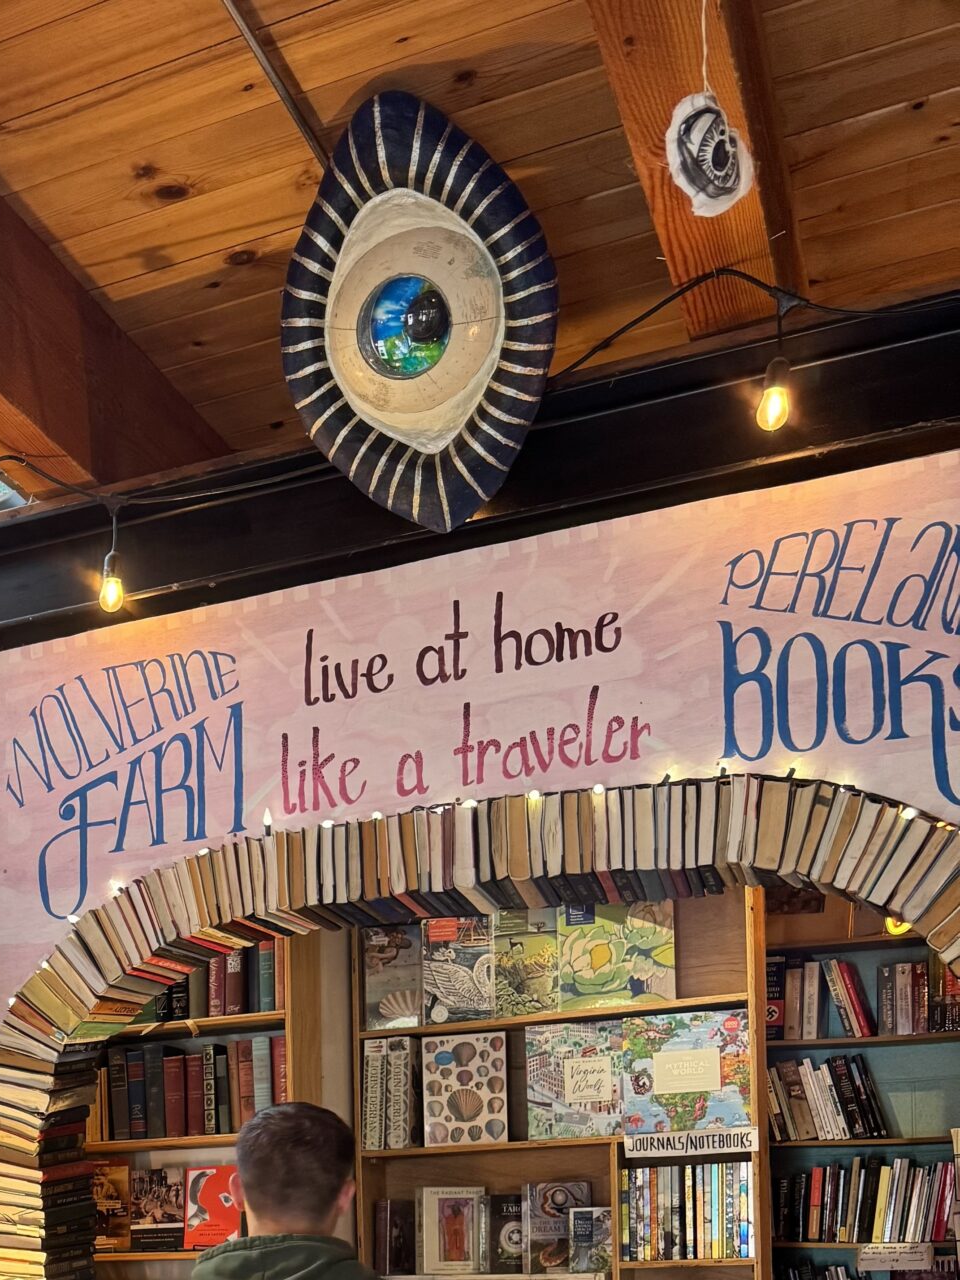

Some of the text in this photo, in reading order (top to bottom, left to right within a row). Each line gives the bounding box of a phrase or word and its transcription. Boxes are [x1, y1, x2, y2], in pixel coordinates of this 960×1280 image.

[304, 591, 623, 706] live at home
[281, 685, 652, 815] like a traveler
[38, 701, 247, 920] FARM
[570, 1063, 608, 1081] Virginia
[665, 1060, 710, 1070] MYTHICAL
[672, 1066, 704, 1076] WORLD
[369, 1063, 379, 1133] JOHN DERIAN
[392, 1061, 402, 1132] JOHN DERIAN
[571, 1081, 605, 1095] Woolf
[628, 1131, 753, 1152] JOURNALS/NOTEBOOKS
